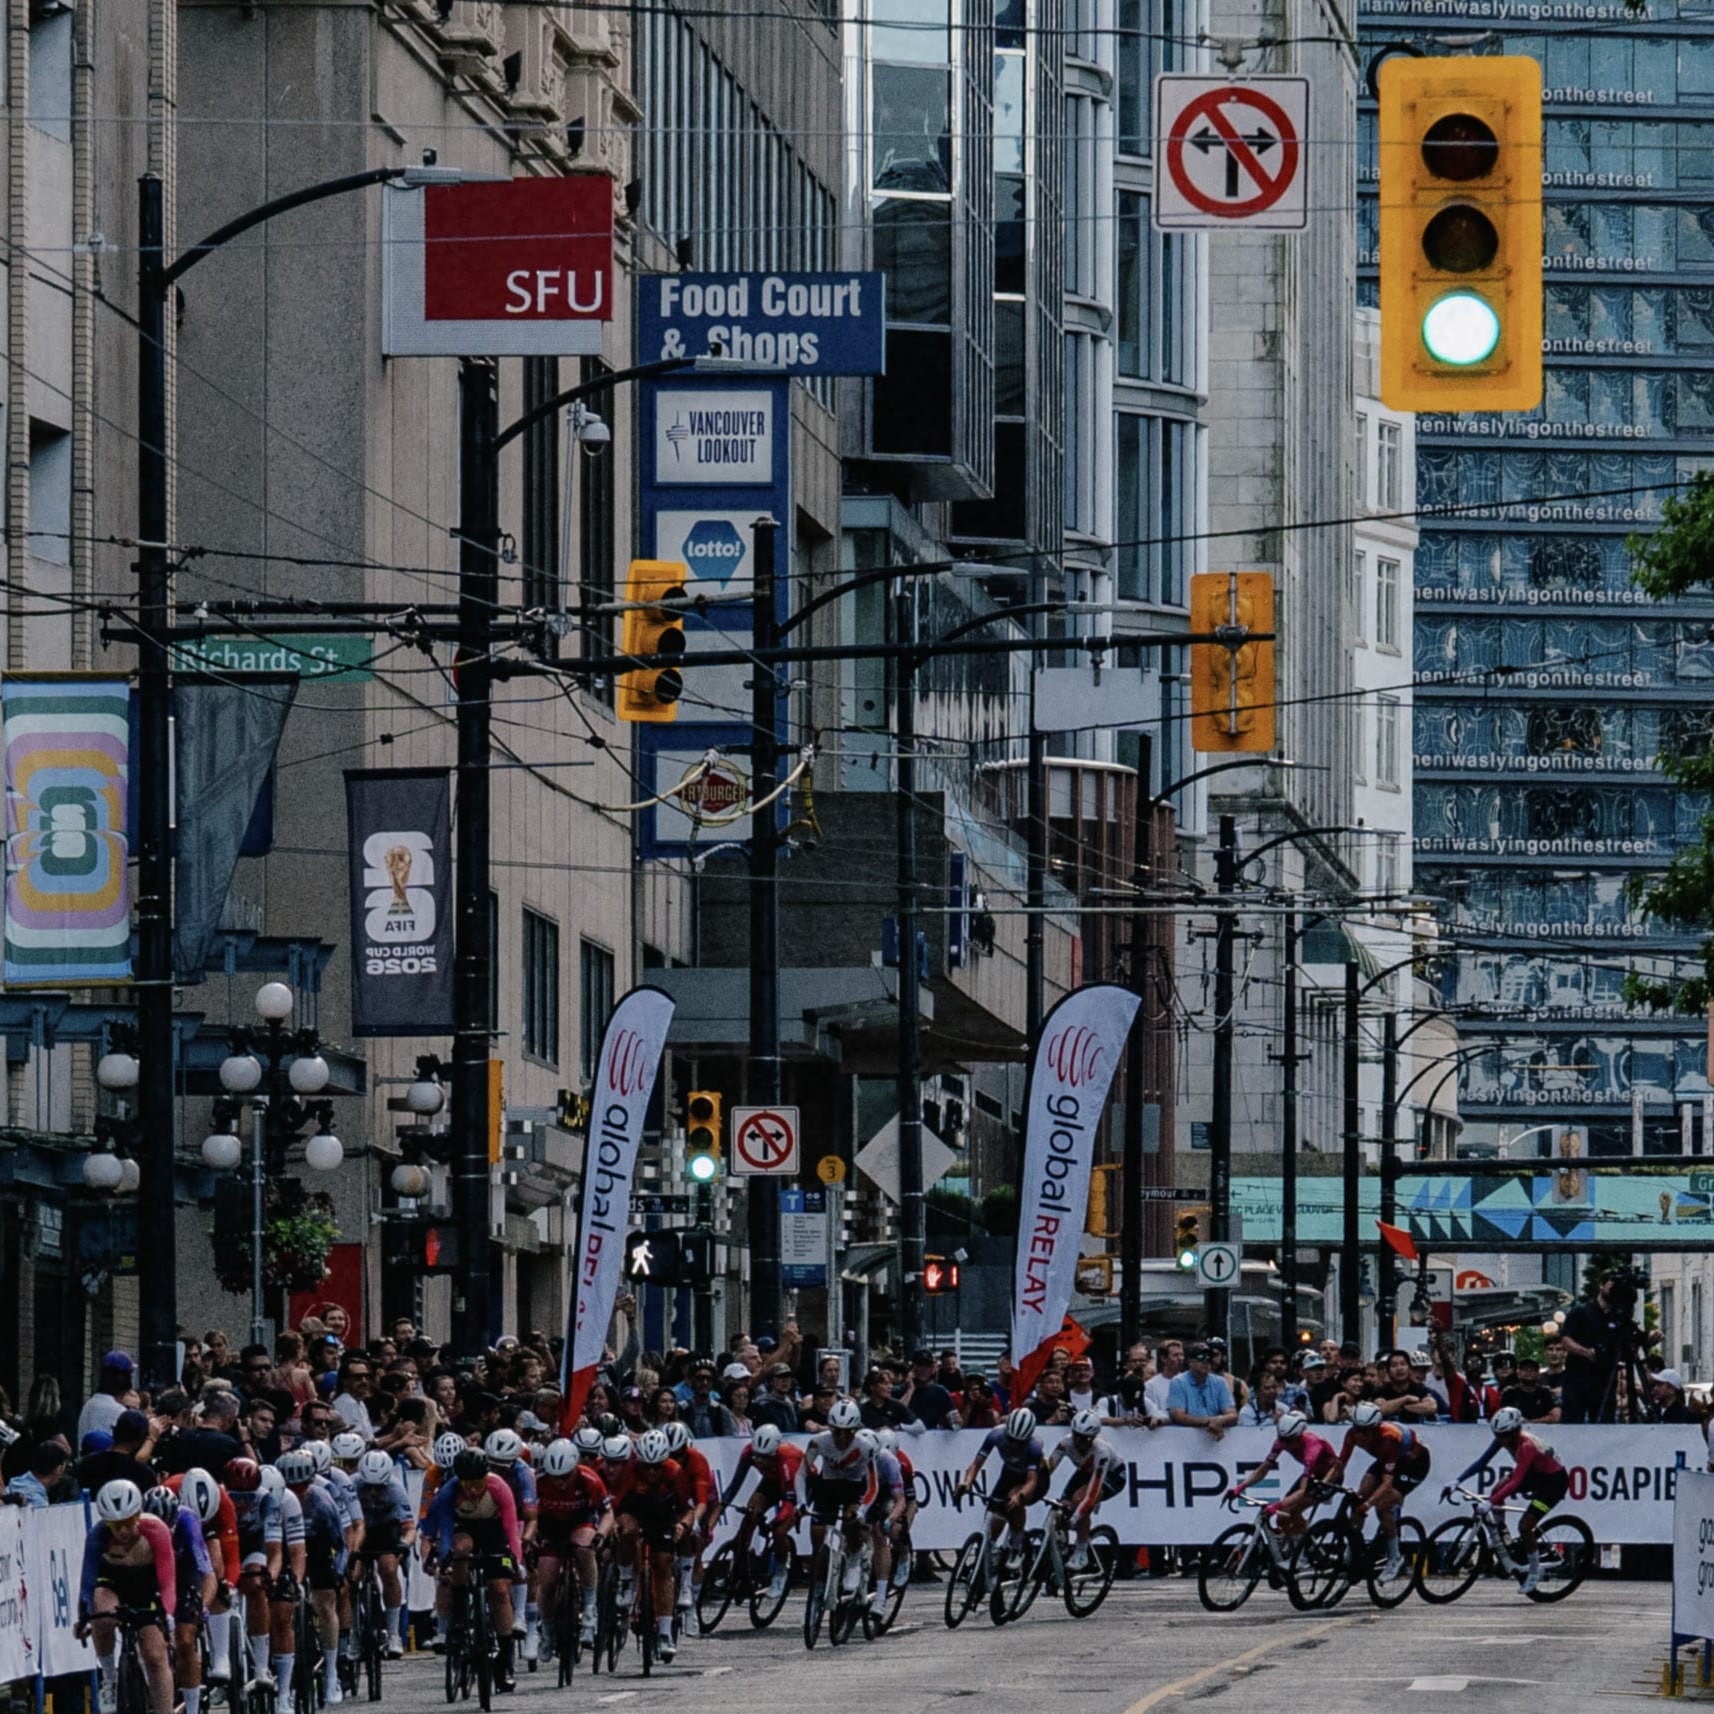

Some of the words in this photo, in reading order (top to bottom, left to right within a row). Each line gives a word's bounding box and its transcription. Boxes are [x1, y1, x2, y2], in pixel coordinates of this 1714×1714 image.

[505, 269, 604, 315] SFU
[660, 278, 749, 319] Food
[760, 278, 863, 318] Court
[661, 328, 688, 360] &
[707, 324, 819, 366] Shops
[688, 410, 765, 438] VANCOUVER
[696, 437, 757, 464] LOOKOUT
[687, 541, 741, 558] Lotto!
[180, 643, 301, 672] Richards
[309, 646, 338, 673] St
[829, 1165, 836, 1178] 3
[1042, 1092, 1083, 1220] global
[1022, 1213, 1060, 1315] RELAY
[916, 1470, 987, 1509] OWN
